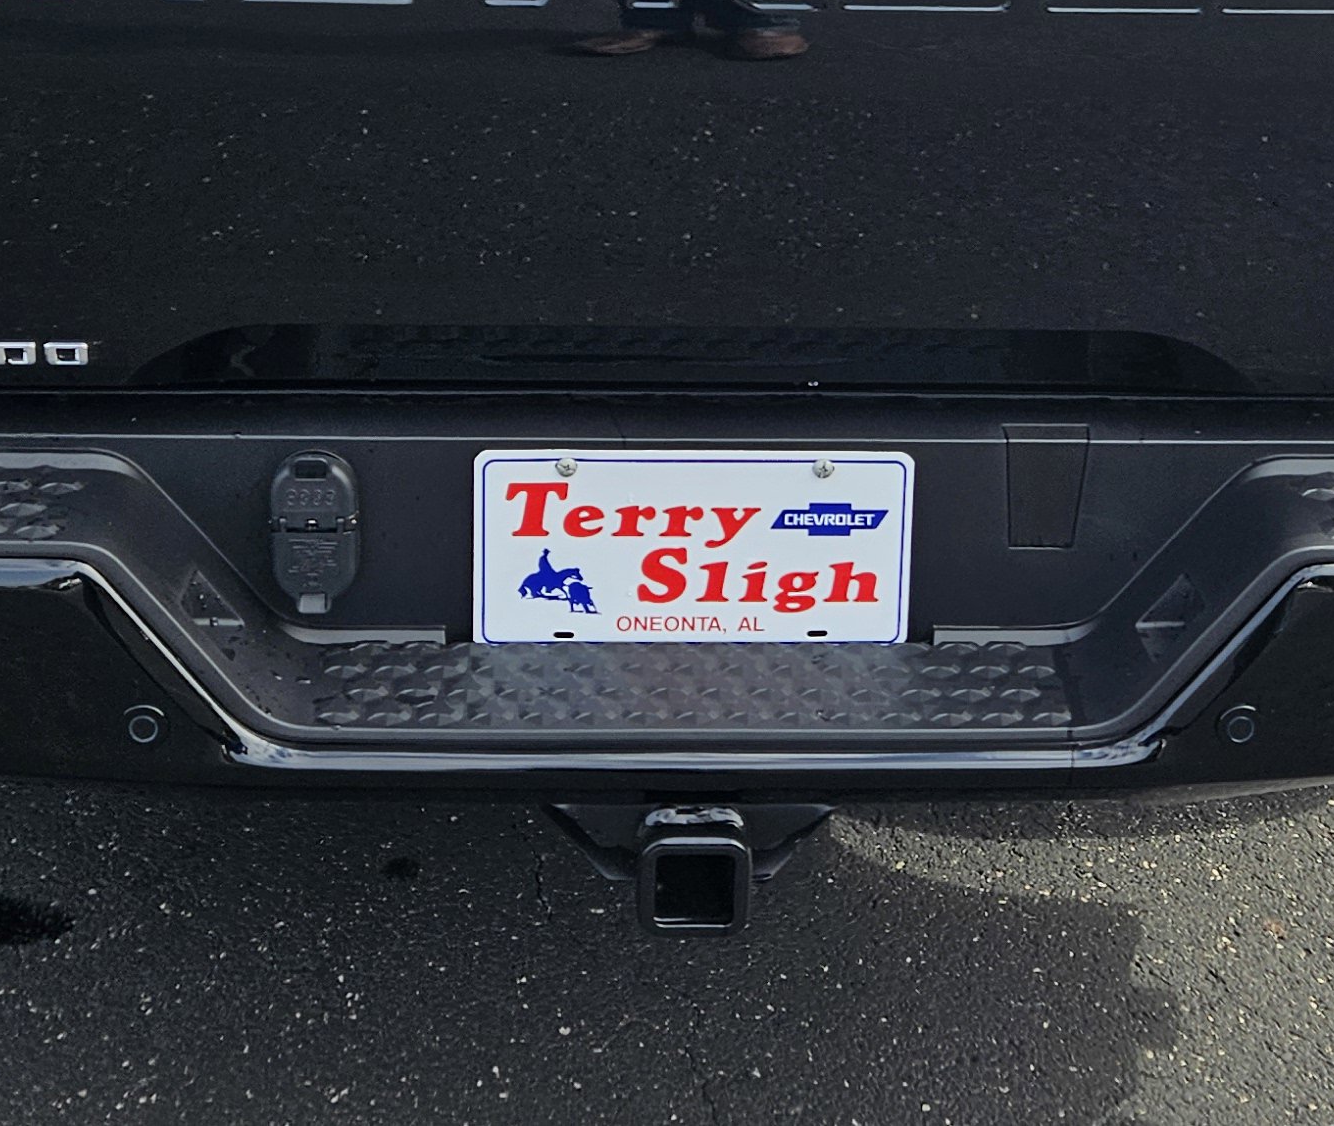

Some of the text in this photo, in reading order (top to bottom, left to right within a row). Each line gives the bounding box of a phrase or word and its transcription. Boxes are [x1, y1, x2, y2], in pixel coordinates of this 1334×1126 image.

[505, 482, 762, 549] Terry
[783, 512, 878, 528] CHEVROLET
[637, 547, 880, 613] Sligh
[616, 616, 766, 635] ONEONTA, AL
